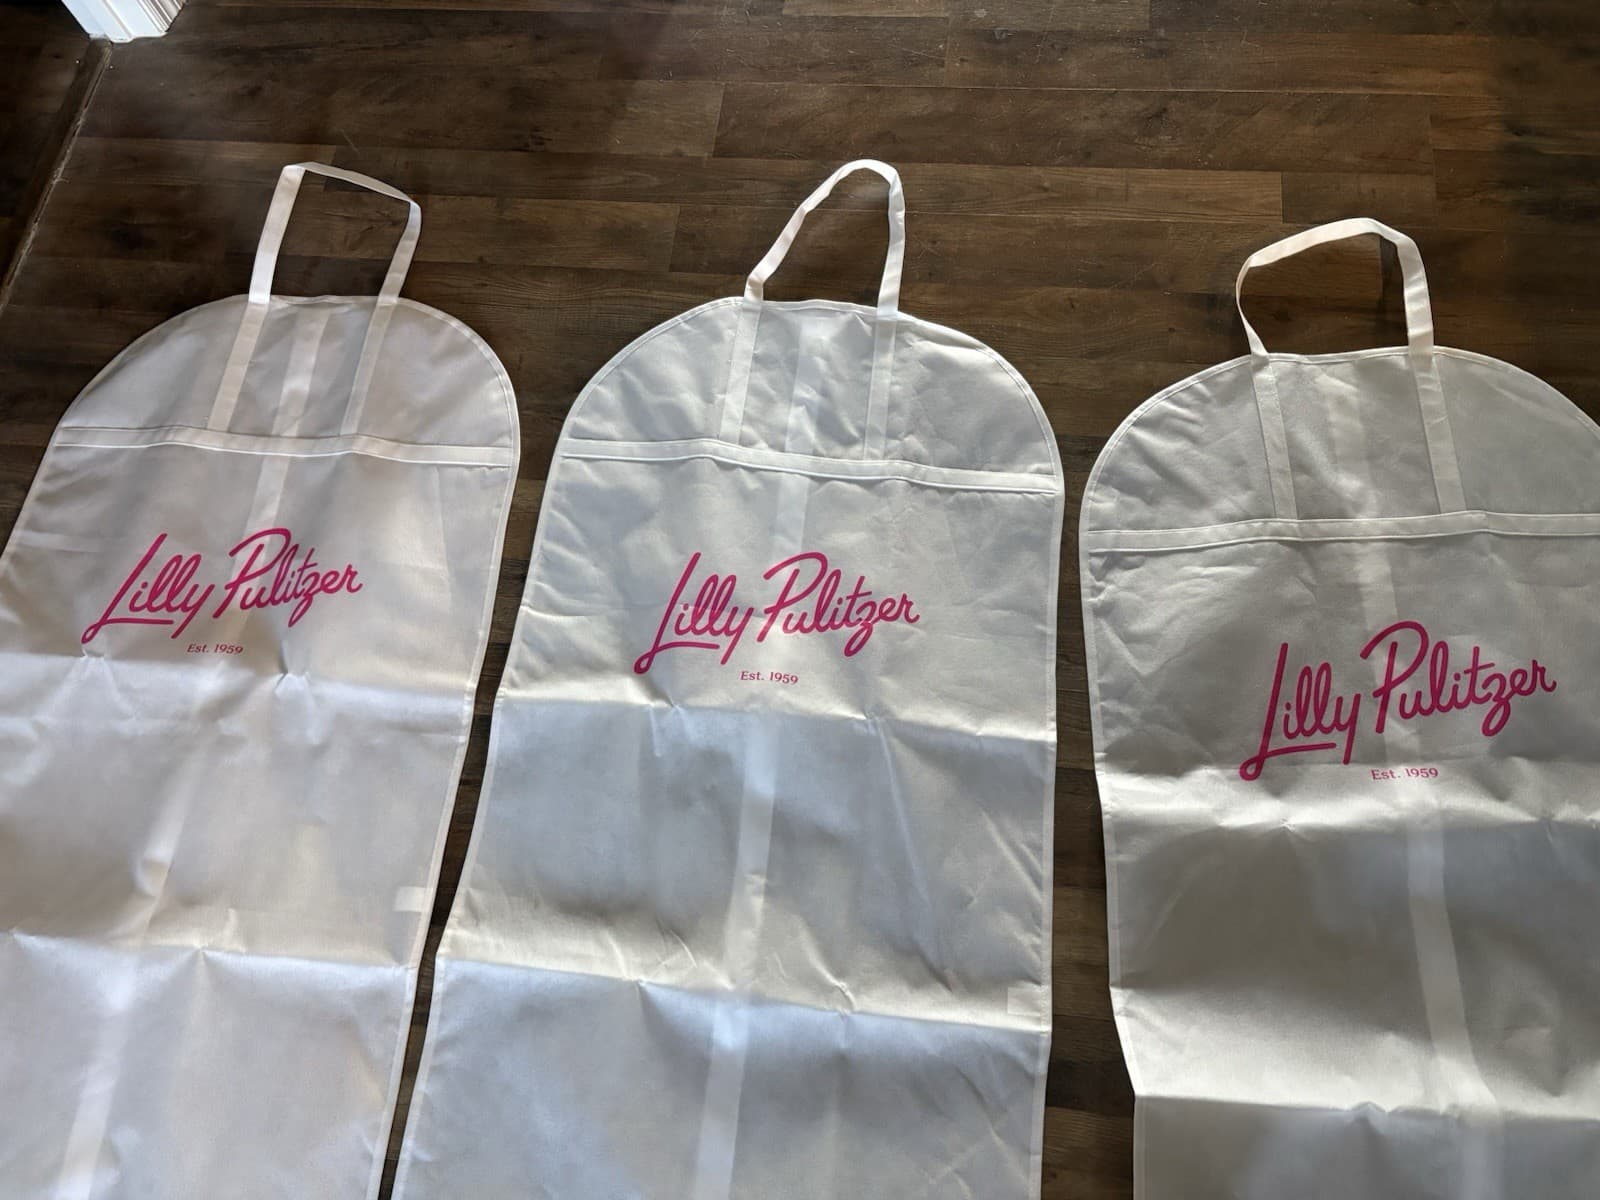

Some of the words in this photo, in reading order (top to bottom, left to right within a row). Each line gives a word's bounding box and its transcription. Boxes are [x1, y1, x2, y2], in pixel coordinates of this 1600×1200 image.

[81, 533, 215, 644] Lilly
[212, 527, 363, 628] Pulitzer
[633, 552, 754, 675] Lilly
[756, 552, 920, 657] Pulitzer
[187, 643, 209, 653] Est.
[214, 643, 244, 655] 1959
[740, 670, 765, 681] Est.
[769, 671, 799, 685] 1959
[1239, 642, 1361, 781] Lilly
[1359, 620, 1557, 737] Pulitzer
[1371, 768, 1400, 781] Est.
[1405, 767, 1439, 779] 1959
